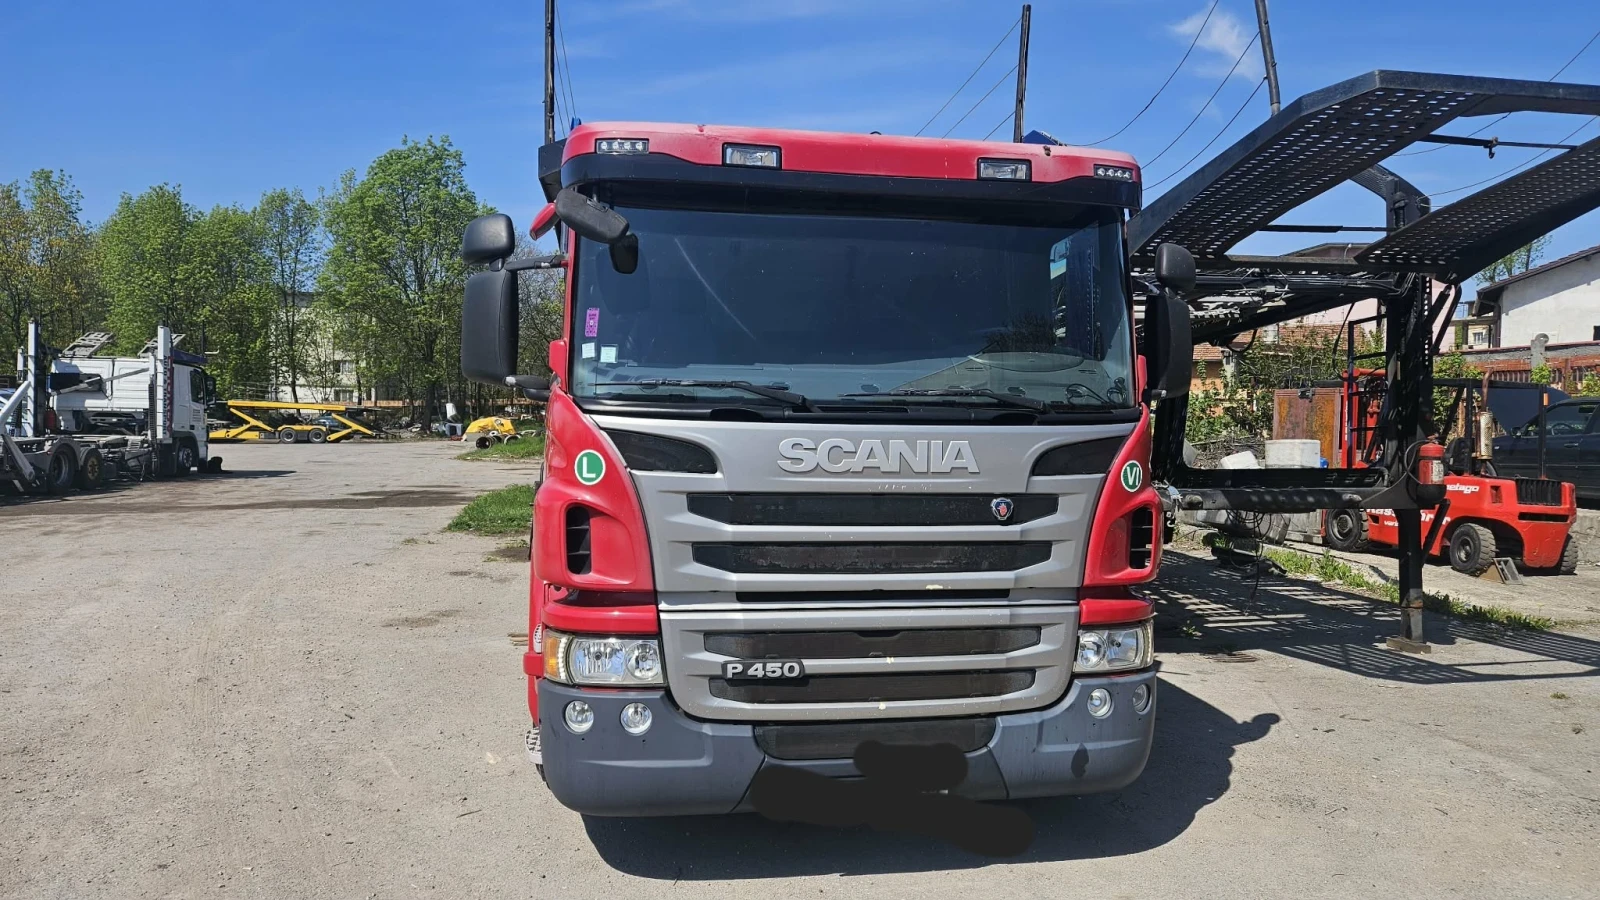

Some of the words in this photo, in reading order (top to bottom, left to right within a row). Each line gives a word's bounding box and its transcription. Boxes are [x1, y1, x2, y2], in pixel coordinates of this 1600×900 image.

[777, 437, 980, 473] SCANIA
[582, 456, 596, 478] L
[1126, 466, 1140, 486] VI
[726, 663, 743, 679] P
[747, 662, 800, 678] 450
